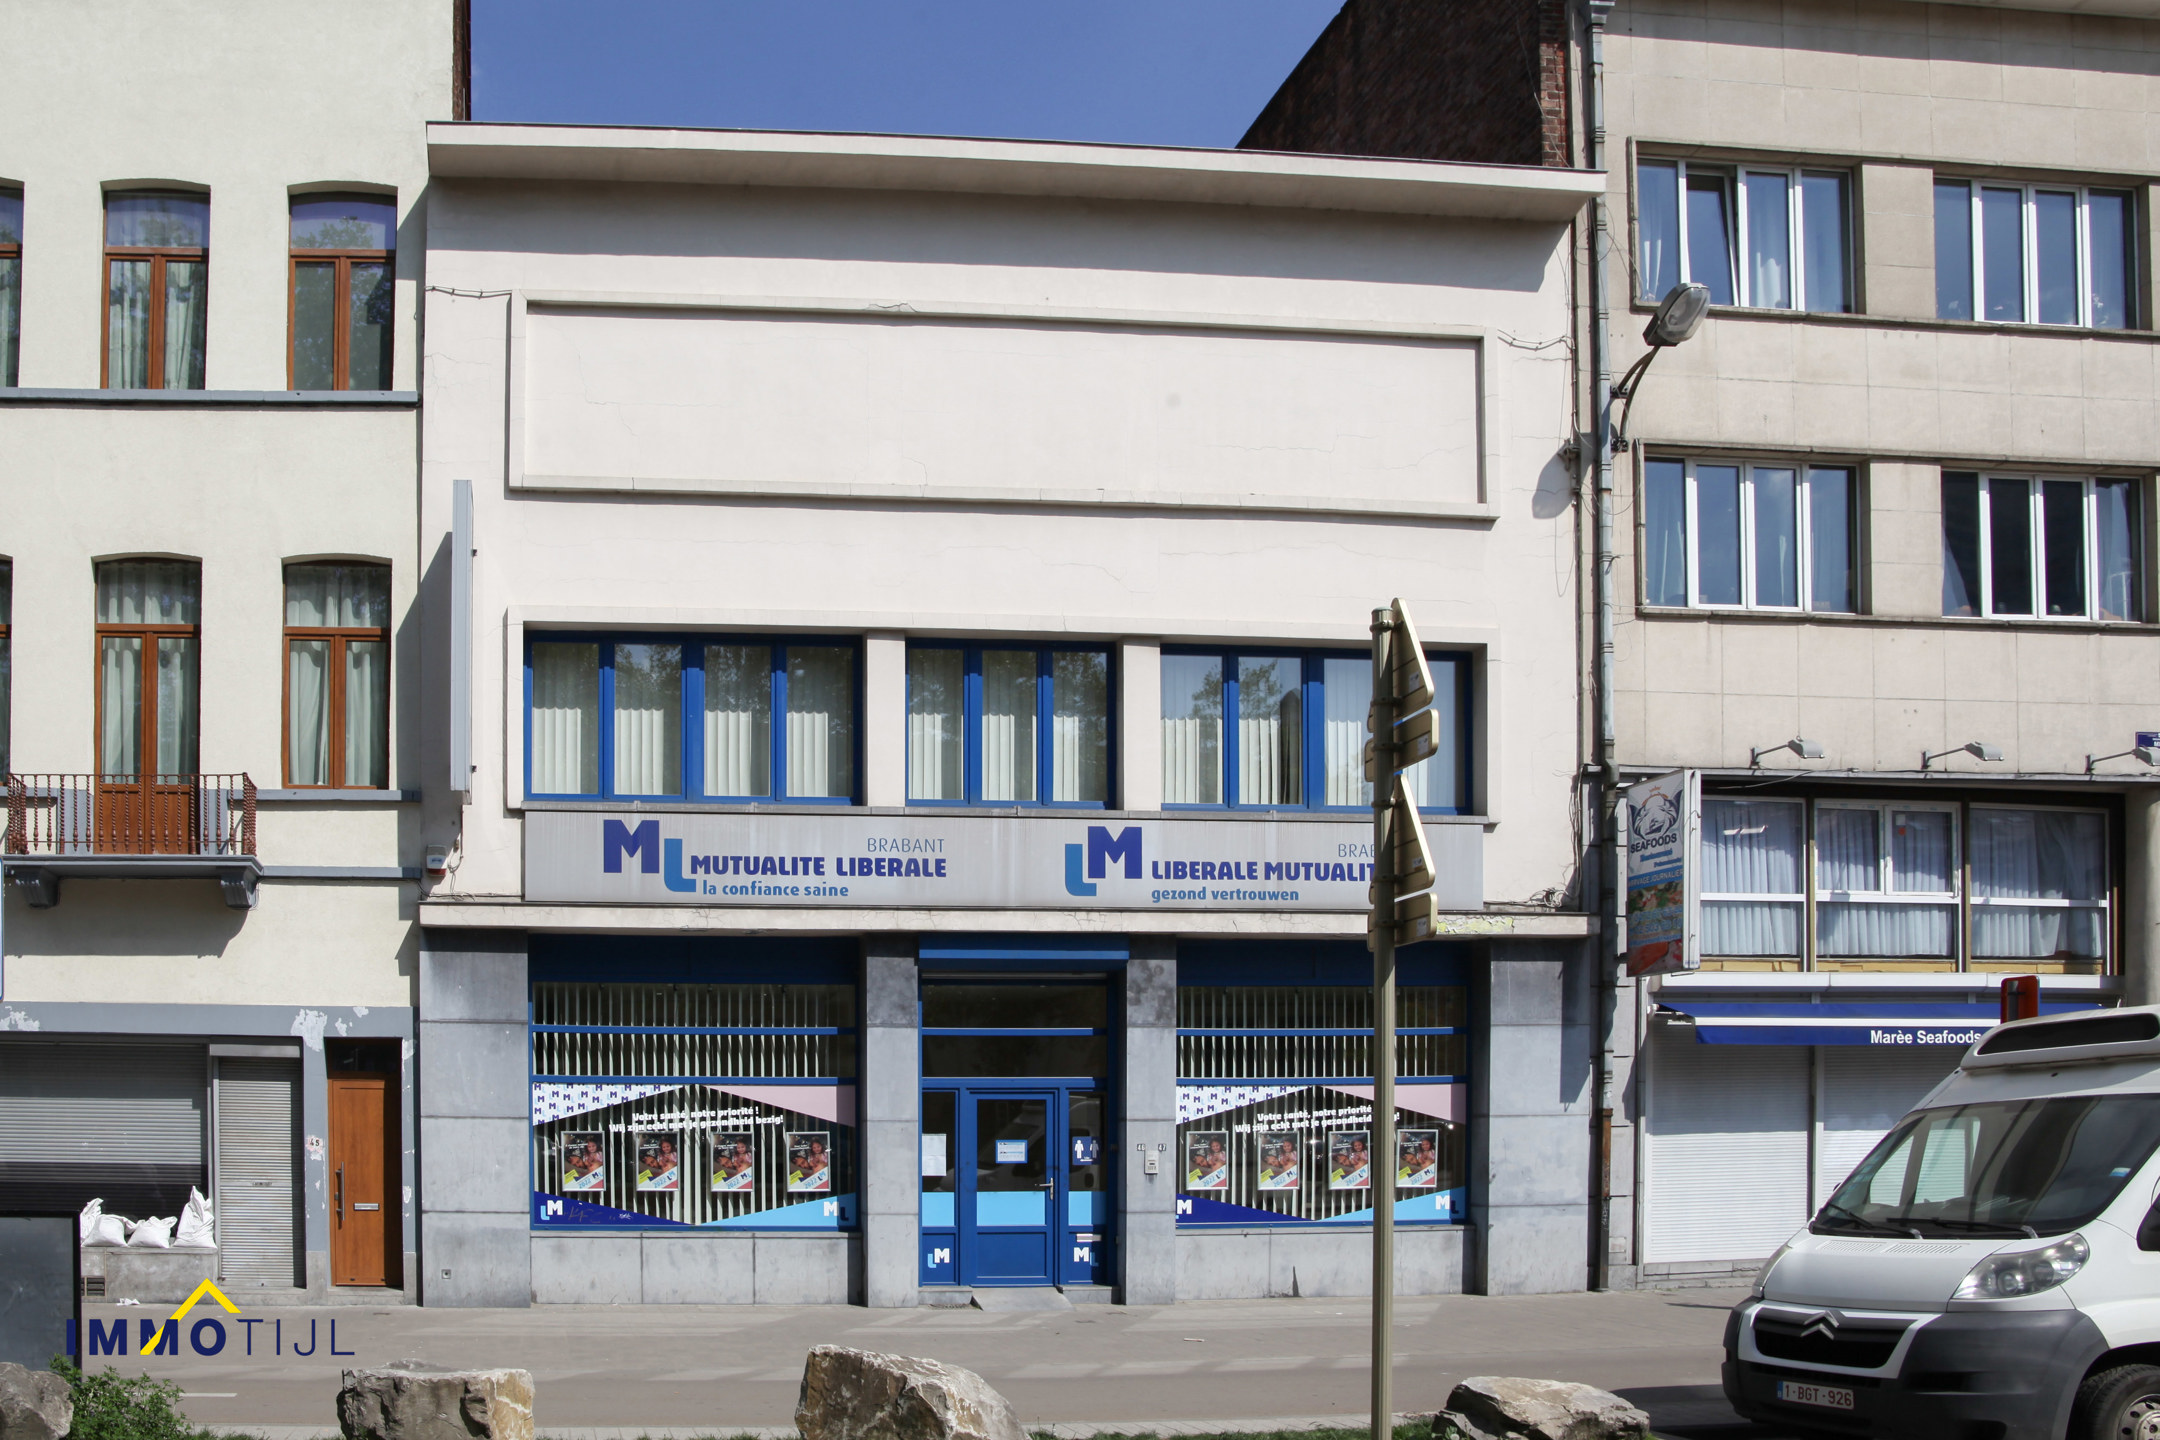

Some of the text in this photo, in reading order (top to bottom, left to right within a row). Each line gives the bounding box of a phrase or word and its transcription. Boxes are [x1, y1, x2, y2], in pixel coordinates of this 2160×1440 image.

[867, 838, 944, 853] BRABANT
[1630, 833, 1677, 854] SEAFOODS
[690, 855, 947, 878] MUTUALITE LIBERALE
[1151, 860, 1258, 880] LIBERALE
[702, 881, 849, 897] la confiance saine
[1151, 887, 1299, 903] gezond vertrouwen
[1870, 1030, 1981, 1044] Marèe Seafoods
[632, 1113, 657, 1121] Votre
[691, 1110, 716, 1118] notre
[718, 1107, 753, 1117] priorité
[1257, 1105, 1372, 1121] Votre santé, notre priorité
[609, 1115, 784, 1133] Wij zijn echt met je gezondheid bezig!
[1235, 1114, 1372, 1133] Wij zijn echt met je gezondheid
